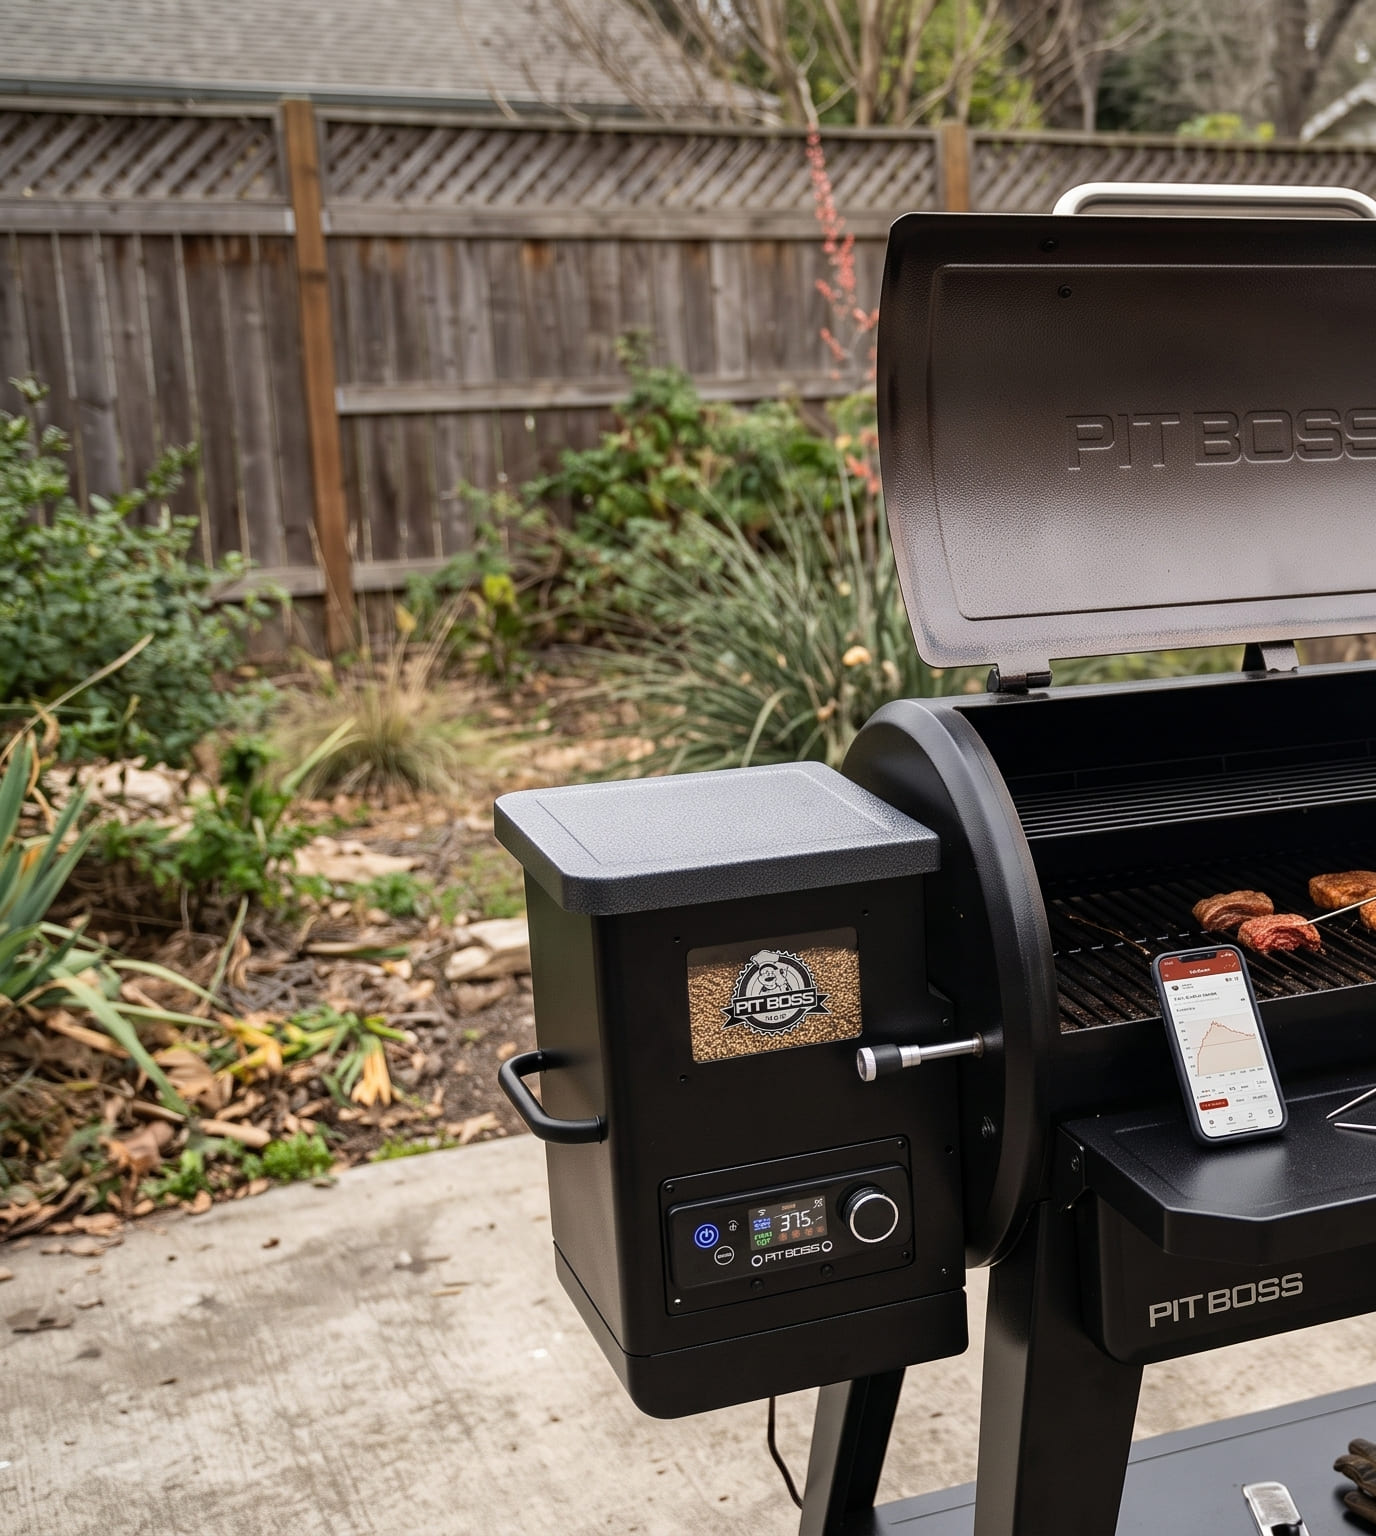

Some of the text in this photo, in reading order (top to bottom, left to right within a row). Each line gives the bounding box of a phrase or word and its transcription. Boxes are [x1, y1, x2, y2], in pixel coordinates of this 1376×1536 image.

[1066, 412, 1180, 471] PIT
[735, 992, 815, 1014] PIT BOSS
[1149, 1272, 1303, 1328] PIT BOSS
